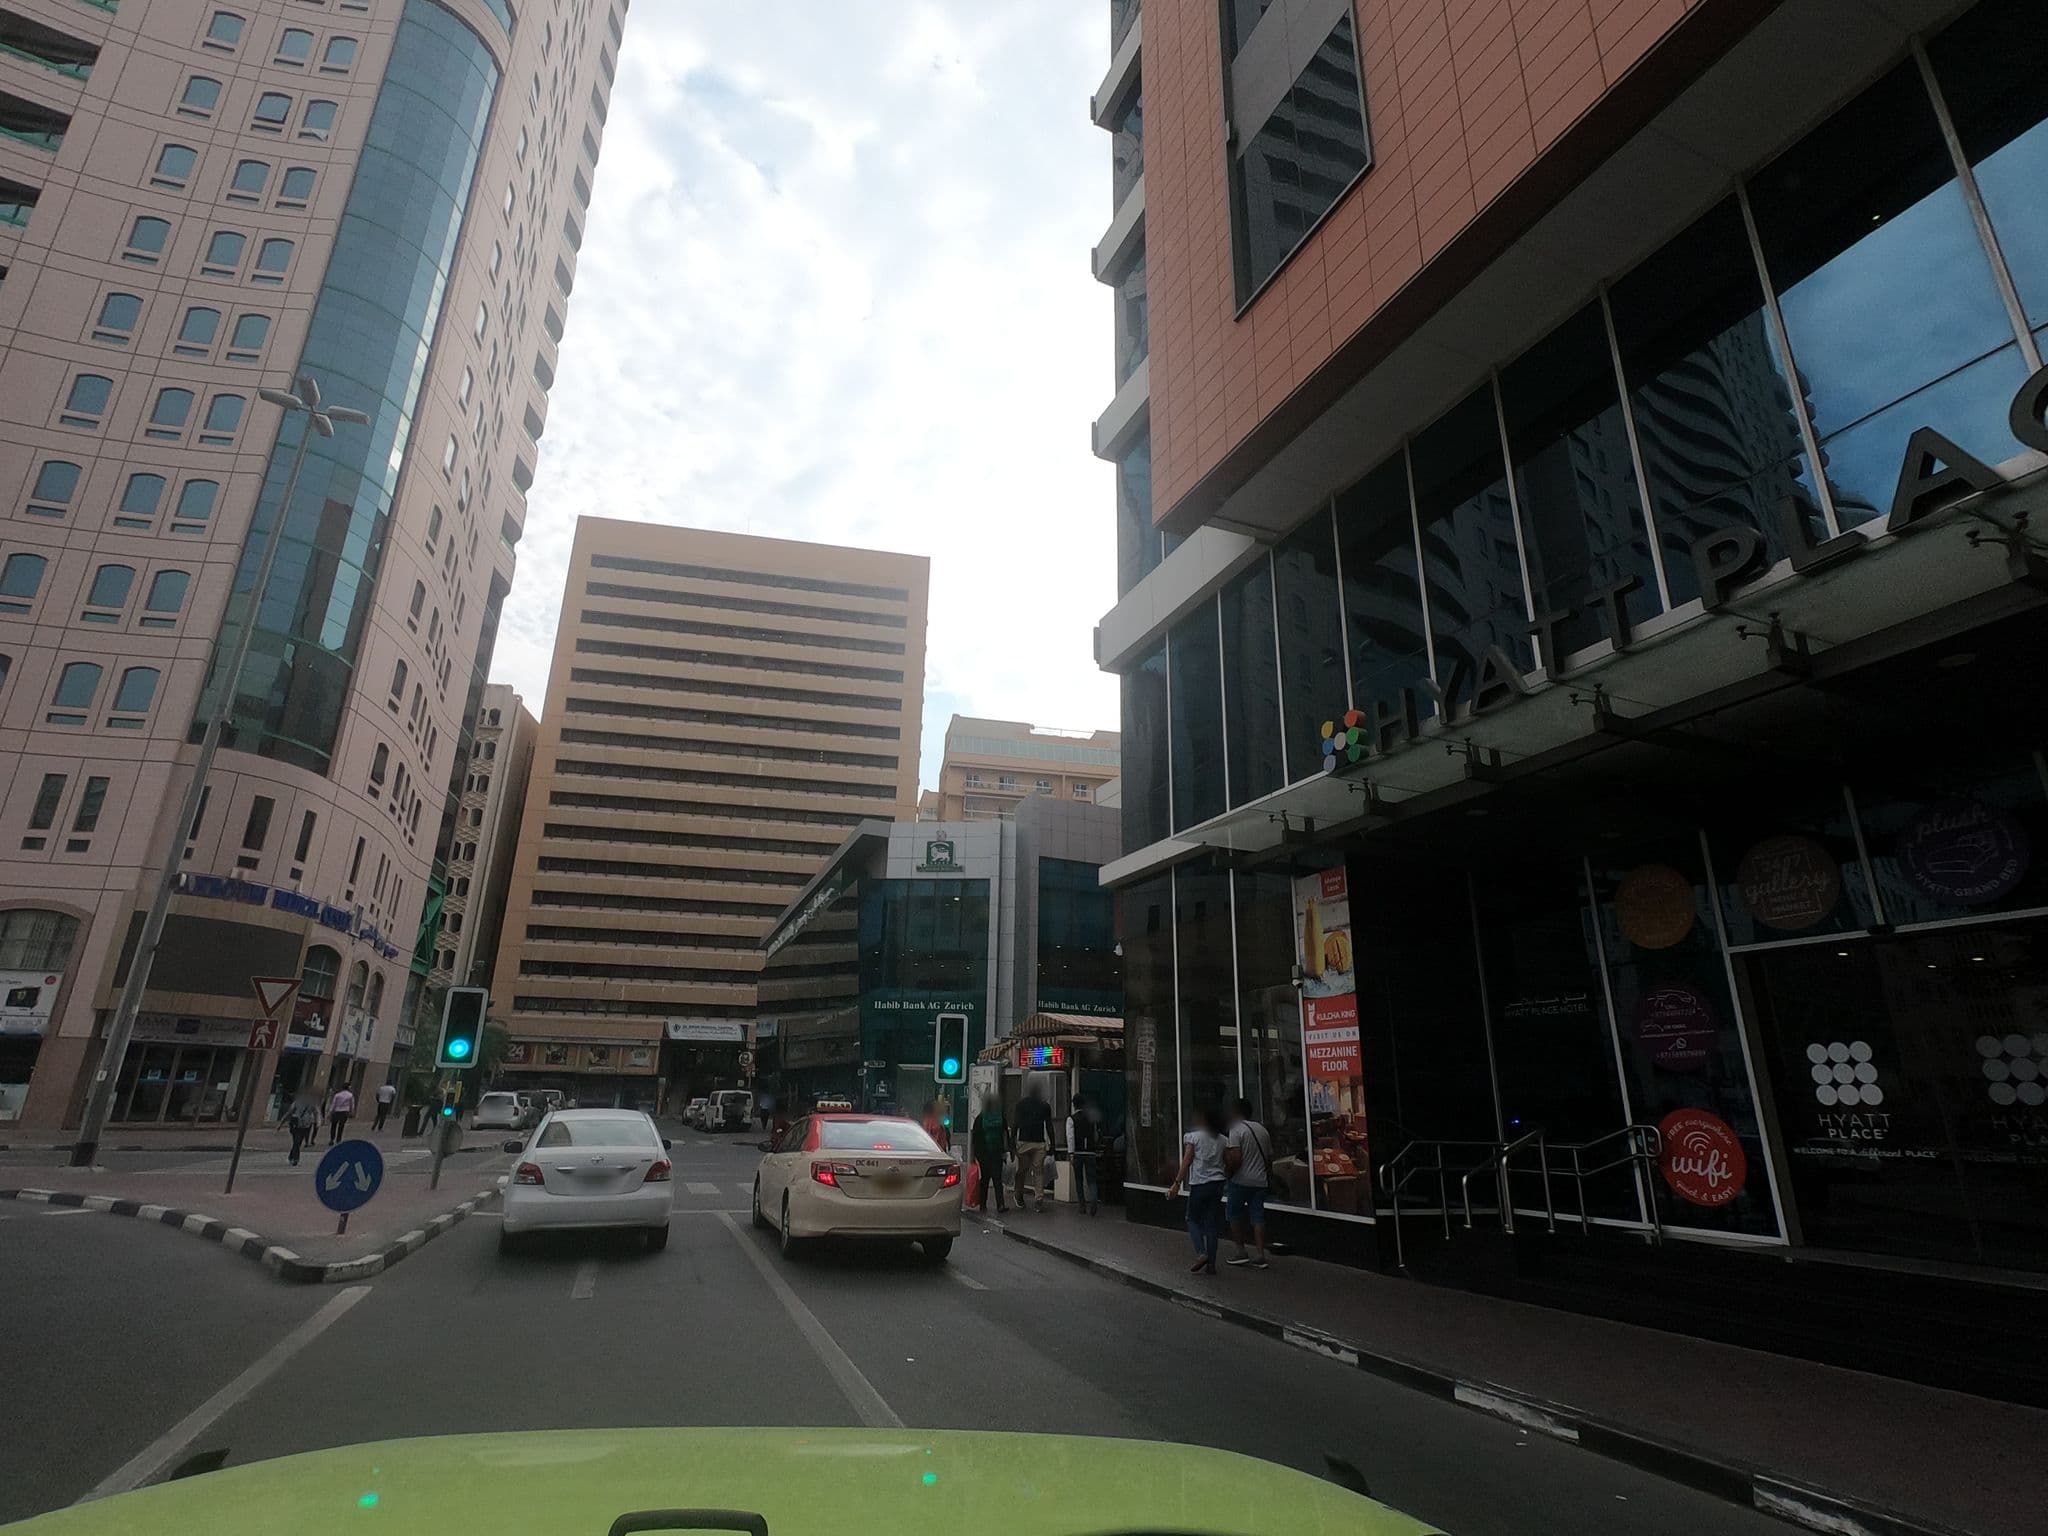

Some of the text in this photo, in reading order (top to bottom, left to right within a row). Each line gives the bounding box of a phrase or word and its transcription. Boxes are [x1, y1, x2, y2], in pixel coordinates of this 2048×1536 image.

[1376, 575, 1645, 757] HYATT
[1917, 804, 1990, 841] plush
[1745, 860, 1828, 904] gallery
[1915, 859, 2019, 897] HYATT GRAND BED
[874, 1001, 975, 1011] Habib Bank AG Zurich
[1038, 1000, 1117, 1013] Habib Bank AG Zurich
[1561, 1002, 1589, 1014] HOTEL
[1316, 1009, 1357, 1020] KULCHA KING
[1309, 1032, 1328, 1040] VISIT
[1310, 1046, 1357, 1059] MEZZANINE
[1322, 1060, 1349, 1071] FLOOR
[1818, 1112, 1893, 1129] HYATT
[1667, 1121, 1683, 1140] FREE
[1828, 1128, 1888, 1140] PLACE
[1672, 1149, 1733, 1188] wifi
